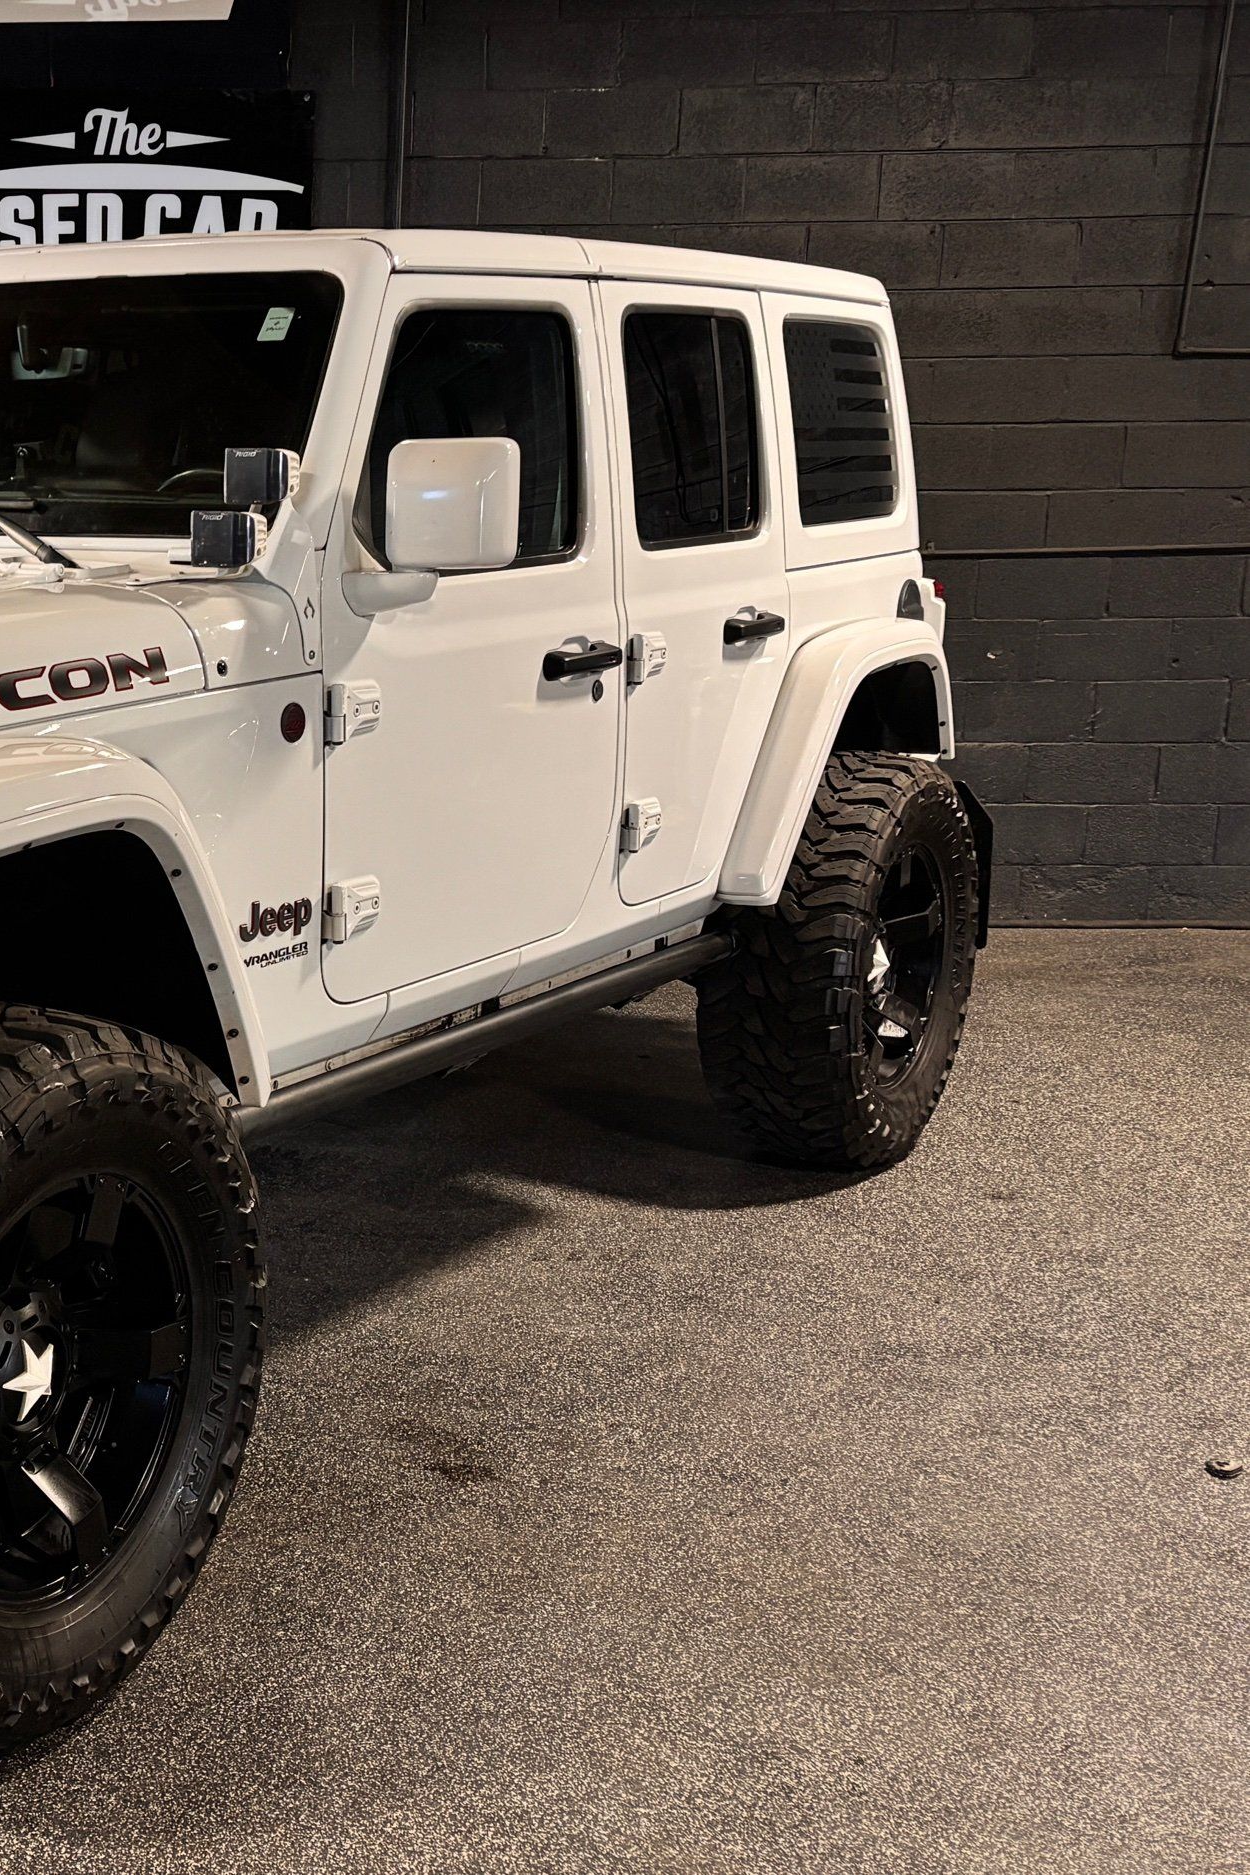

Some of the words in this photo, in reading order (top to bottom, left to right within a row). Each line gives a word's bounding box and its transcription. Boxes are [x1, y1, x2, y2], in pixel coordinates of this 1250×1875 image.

[84, 107, 165, 156] The
[239, 896, 313, 943] Jeep
[260, 950, 309, 968] UNLIMITED
[174, 1259, 237, 1538] COUNTRY
